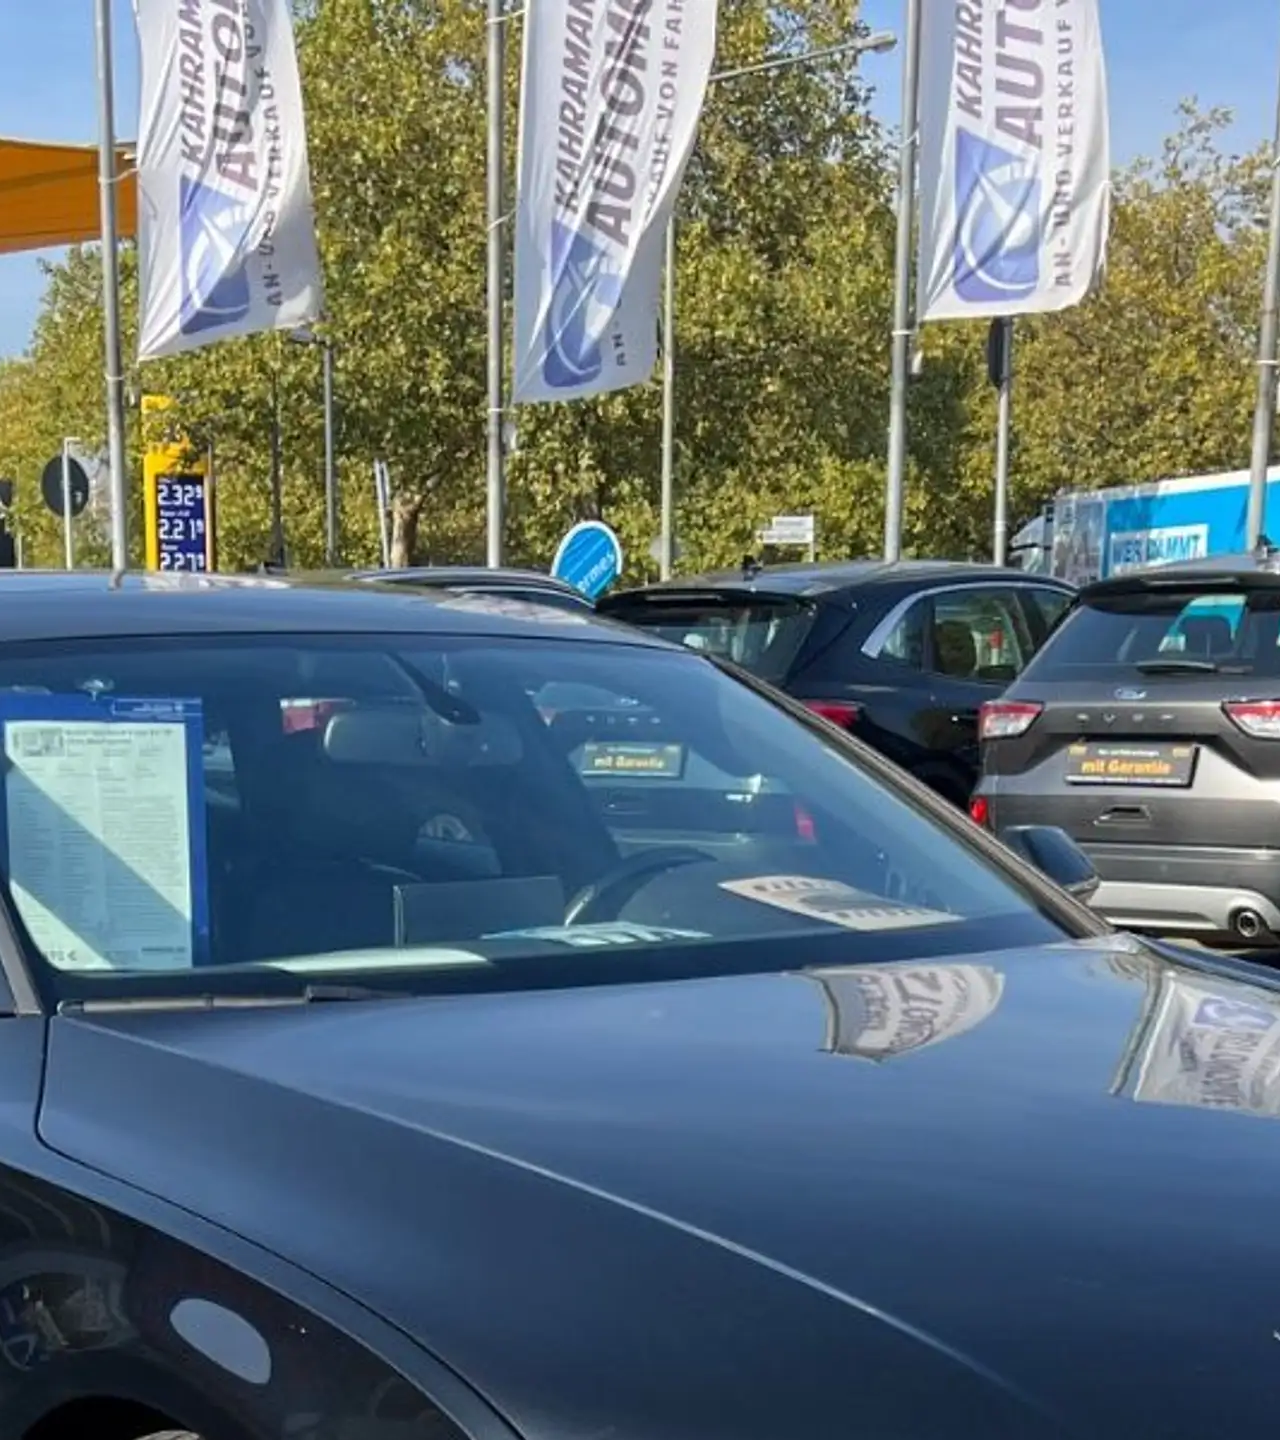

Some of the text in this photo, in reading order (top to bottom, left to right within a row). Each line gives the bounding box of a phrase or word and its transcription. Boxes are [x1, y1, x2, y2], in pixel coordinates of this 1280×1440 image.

[955, 0, 983, 119] KAHR
[1056, 19, 1075, 158] VERKAUF
[577, 551, 616, 593] ermes
